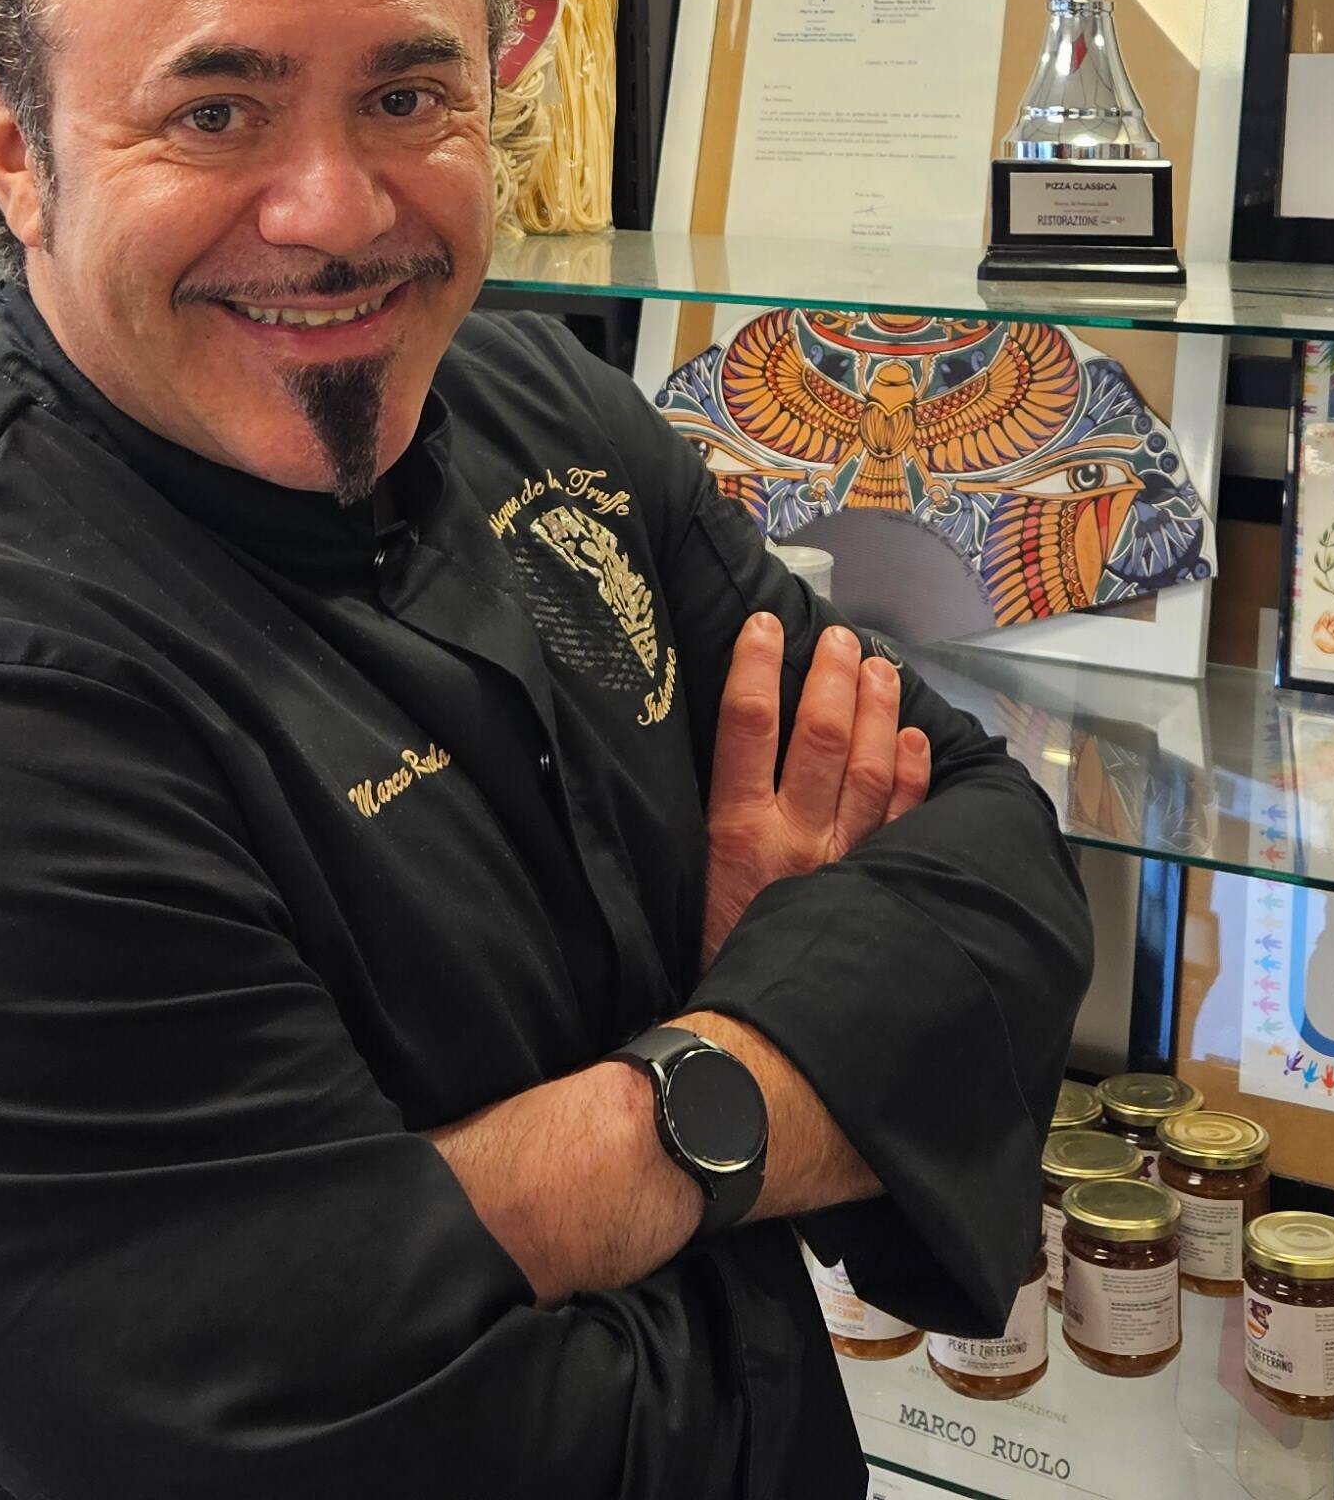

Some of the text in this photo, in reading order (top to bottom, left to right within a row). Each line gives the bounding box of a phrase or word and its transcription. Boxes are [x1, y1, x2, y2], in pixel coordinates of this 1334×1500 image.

[1045, 182, 1118, 191] PIZZA CLASSICA
[1037, 214, 1100, 227] RISTORAZIONE
[521, 478, 546, 505] de
[566, 467, 632, 517] Truffe
[898, 1403, 1071, 1480] MARCO RUOLO
